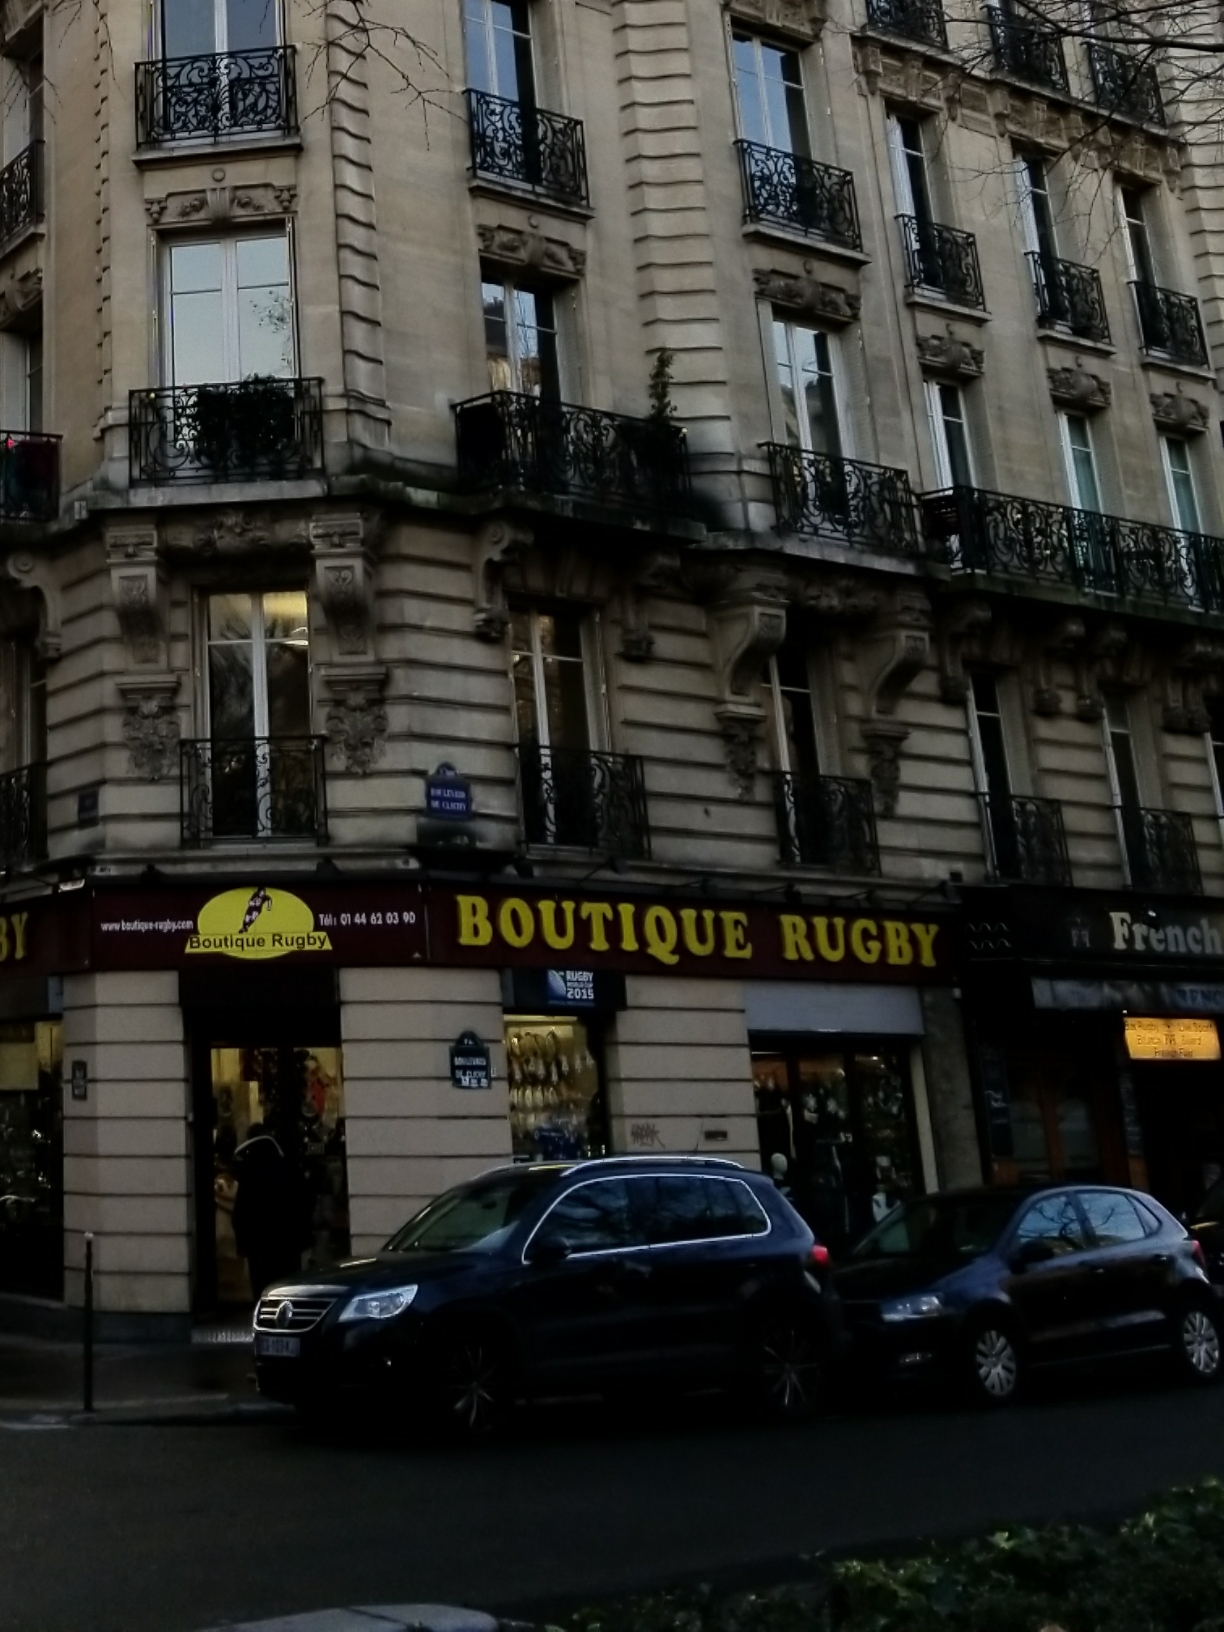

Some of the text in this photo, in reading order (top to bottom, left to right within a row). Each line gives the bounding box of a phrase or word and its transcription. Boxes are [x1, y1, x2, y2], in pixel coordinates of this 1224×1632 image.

[340, 912, 351, 926] 01
[354, 912, 367, 925] 44
[370, 911, 383, 925] 62
[386, 911, 399, 925] 03
[402, 911, 416, 924] 90
[455, 894, 940, 968] BOUTIQUE RUGBY
[1109, 911, 1224, 956] French
[189, 933, 327, 951] Boutique Rugby
[566, 970, 594, 982] RUGBY
[566, 988, 595, 1000] 2015
